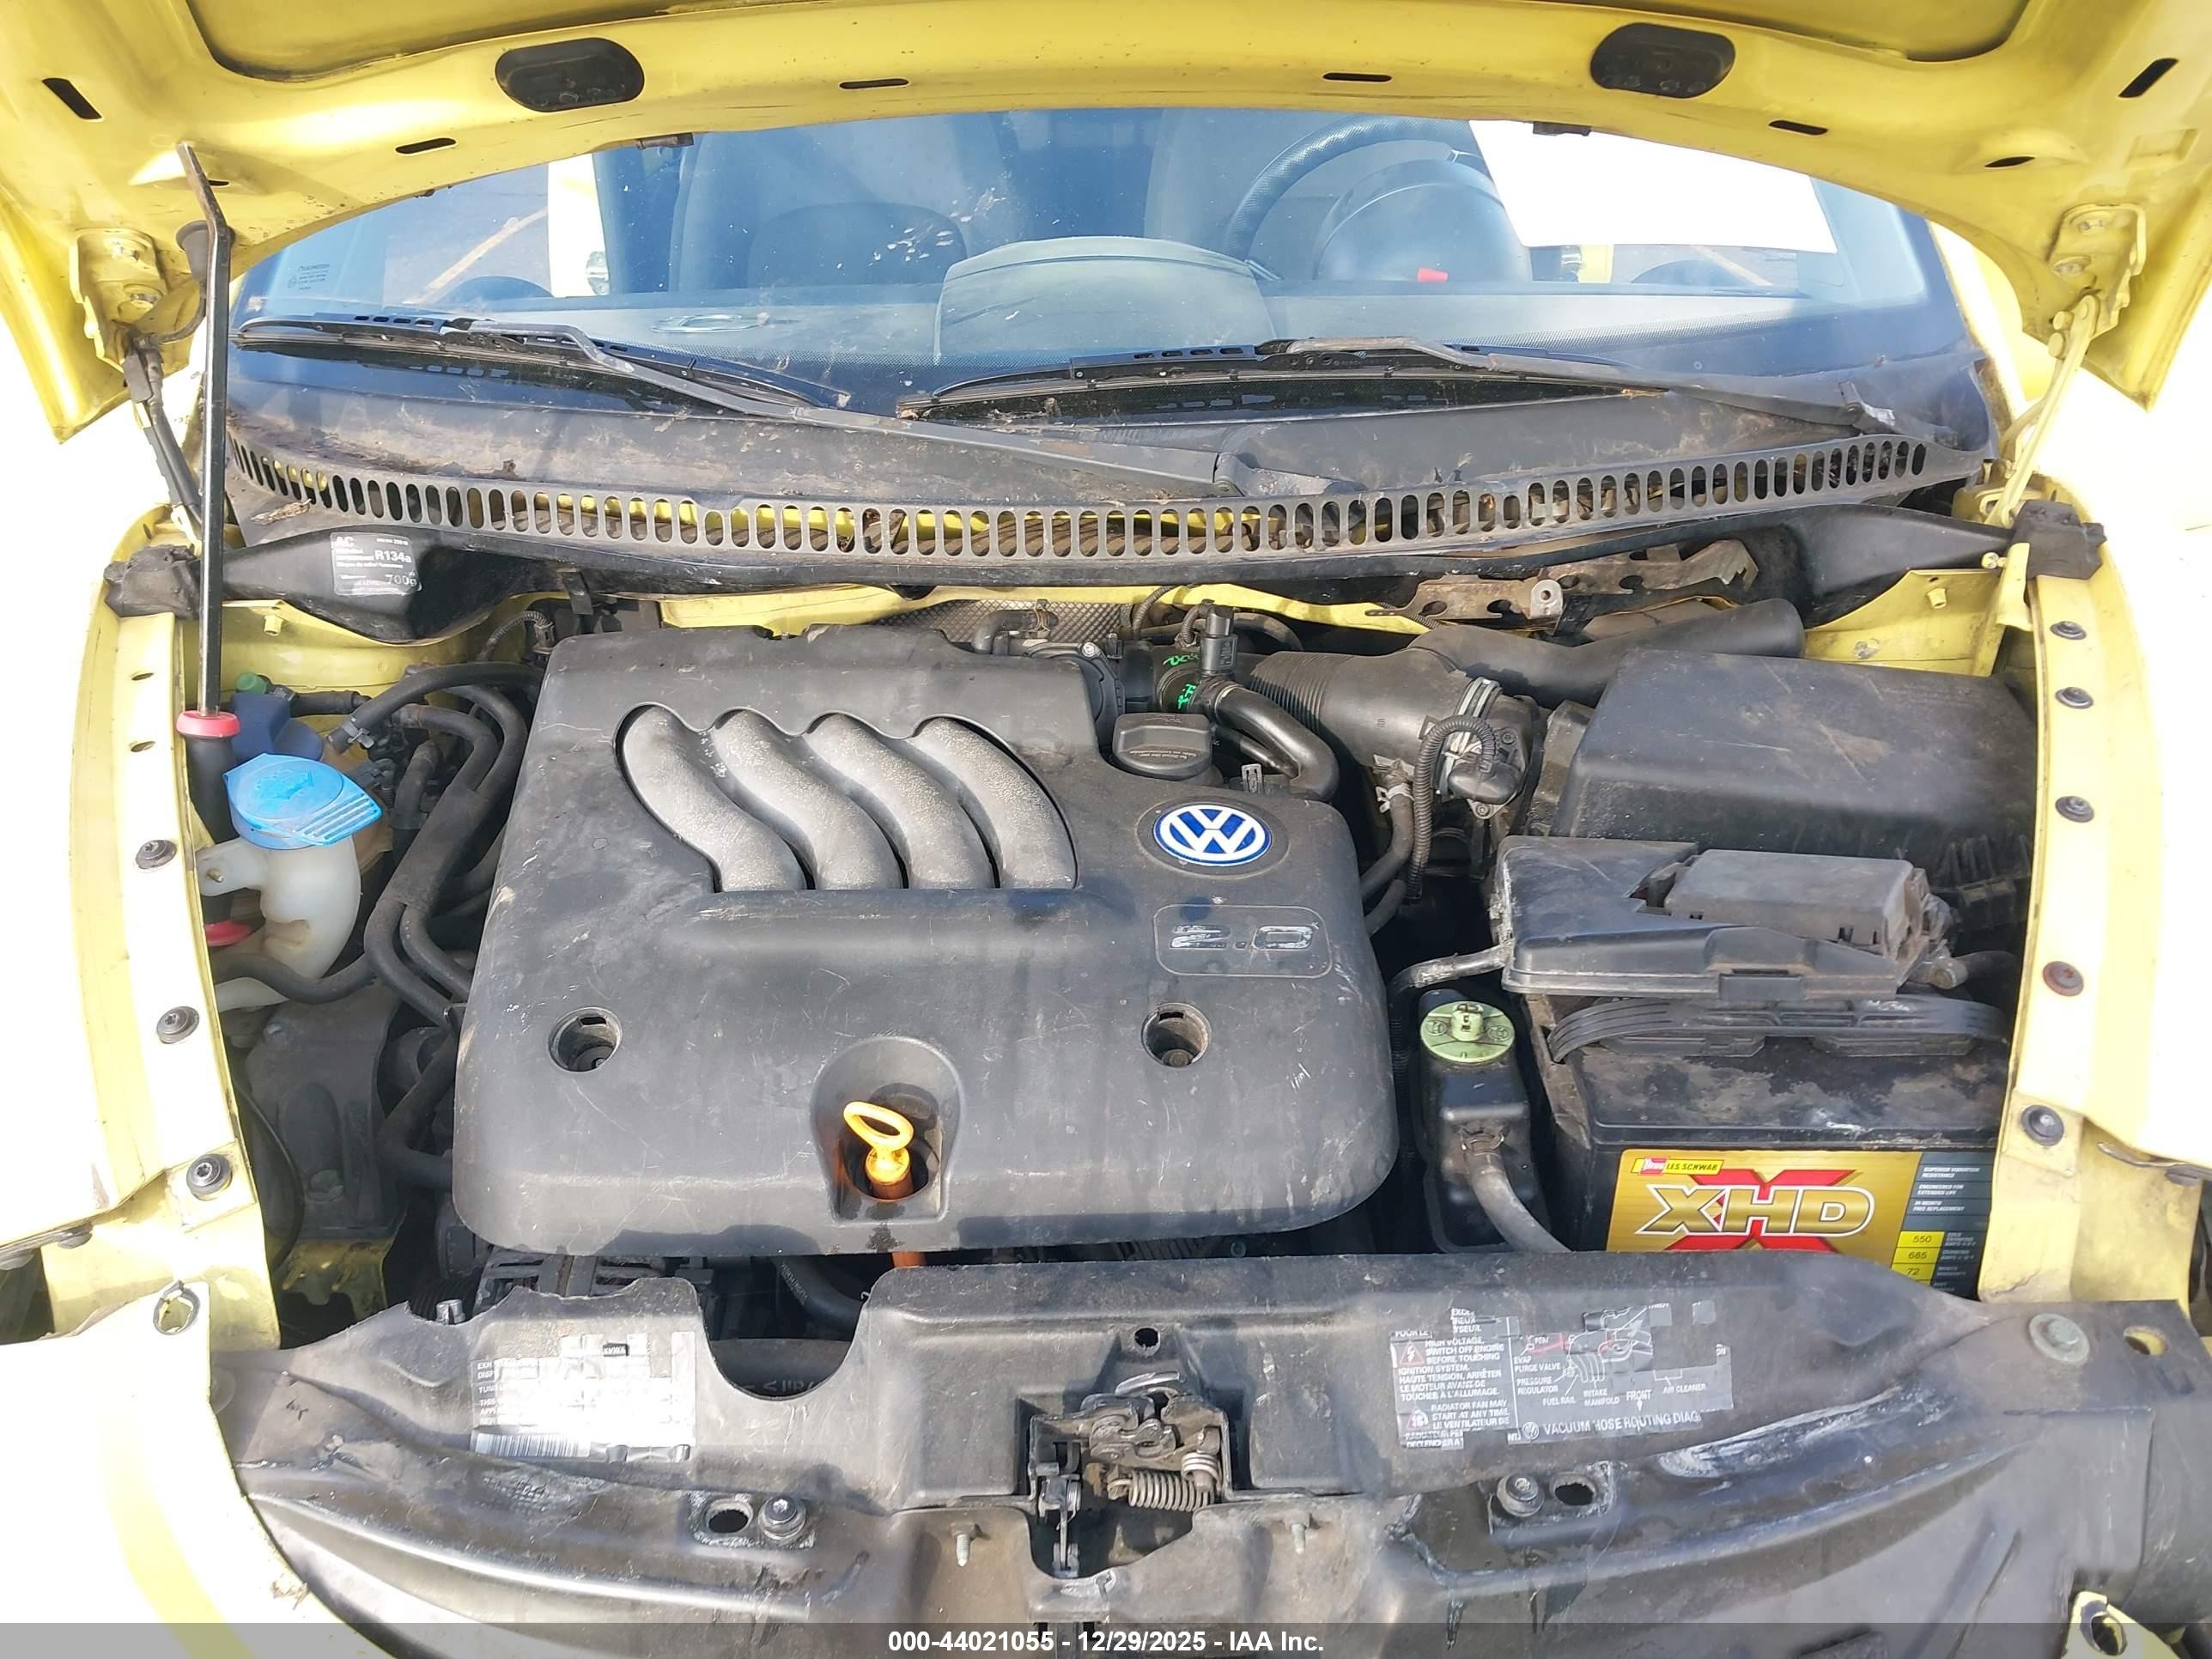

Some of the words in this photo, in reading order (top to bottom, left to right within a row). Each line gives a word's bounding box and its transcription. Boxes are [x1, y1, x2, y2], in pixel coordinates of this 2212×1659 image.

[336, 537, 355, 547] AC
[374, 550, 413, 563] R134a
[384, 574, 417, 586] 700g
[1170, 924, 1313, 950] 2.0
[1666, 1163, 1681, 1171] LES
[1682, 1163, 1718, 1172] SCHWAB
[1635, 1184, 1875, 1237] XHD
[1912, 1235, 1932, 1243] 550
[1426, 1346, 1458, 1356] SWITCH
[1458, 1346, 1474, 1355] OFF
[1474, 1343, 1505, 1352] ENGINE
[1427, 1355, 1458, 1364] BEFORE
[1460, 1352, 1501, 1363] TOUCHING
[1514, 1356, 1532, 1364] EVAP
[1398, 1365, 1434, 1376] IGNITION
[1514, 1364, 1539, 1373] PURGE
[1539, 1362, 1561, 1372] VALVE
[1399, 1374, 1427, 1384] HAUTE
[1517, 1376, 1552, 1386] PRESSURE
[1400, 1383, 1411, 1393] LE
[1412, 1382, 1446, 1392] MOTEUR
[1447, 1380, 1474, 1389] AVANT
[1474, 1379, 1486, 1389] DE
[1517, 1385, 1559, 1395] REGULATOR
[1662, 1385, 1675, 1395] AIR
[1675, 1382, 1708, 1393] CLEANER
[1401, 1391, 1439, 1401] TOUCHER
[1583, 1388, 1608, 1398] INTAKE
[1626, 1389, 1652, 1402] FRONT
[1431, 1401, 1471, 1413] RADIATOR
[1471, 1401, 1489, 1410] FAN
[1489, 1400, 1507, 1408] MAY
[1542, 1396, 1562, 1407] FUEL
[1562, 1395, 1577, 1405] RAIL
[1584, 1396, 1620, 1407] MANIFOLD
[1432, 1411, 1458, 1421] START
[1459, 1409, 1470, 1419] AT
[1471, 1409, 1488, 1418] ANY
[1432, 1421, 1443, 1430] LE
[1443, 1419, 1498, 1430] VENTILATEUR
[1498, 1416, 1510, 1425] DE
[1543, 1421, 1591, 1435] VACUUM
[1594, 1417, 1623, 1430] HOSE
[1623, 1413, 1671, 1429] ROUTING
